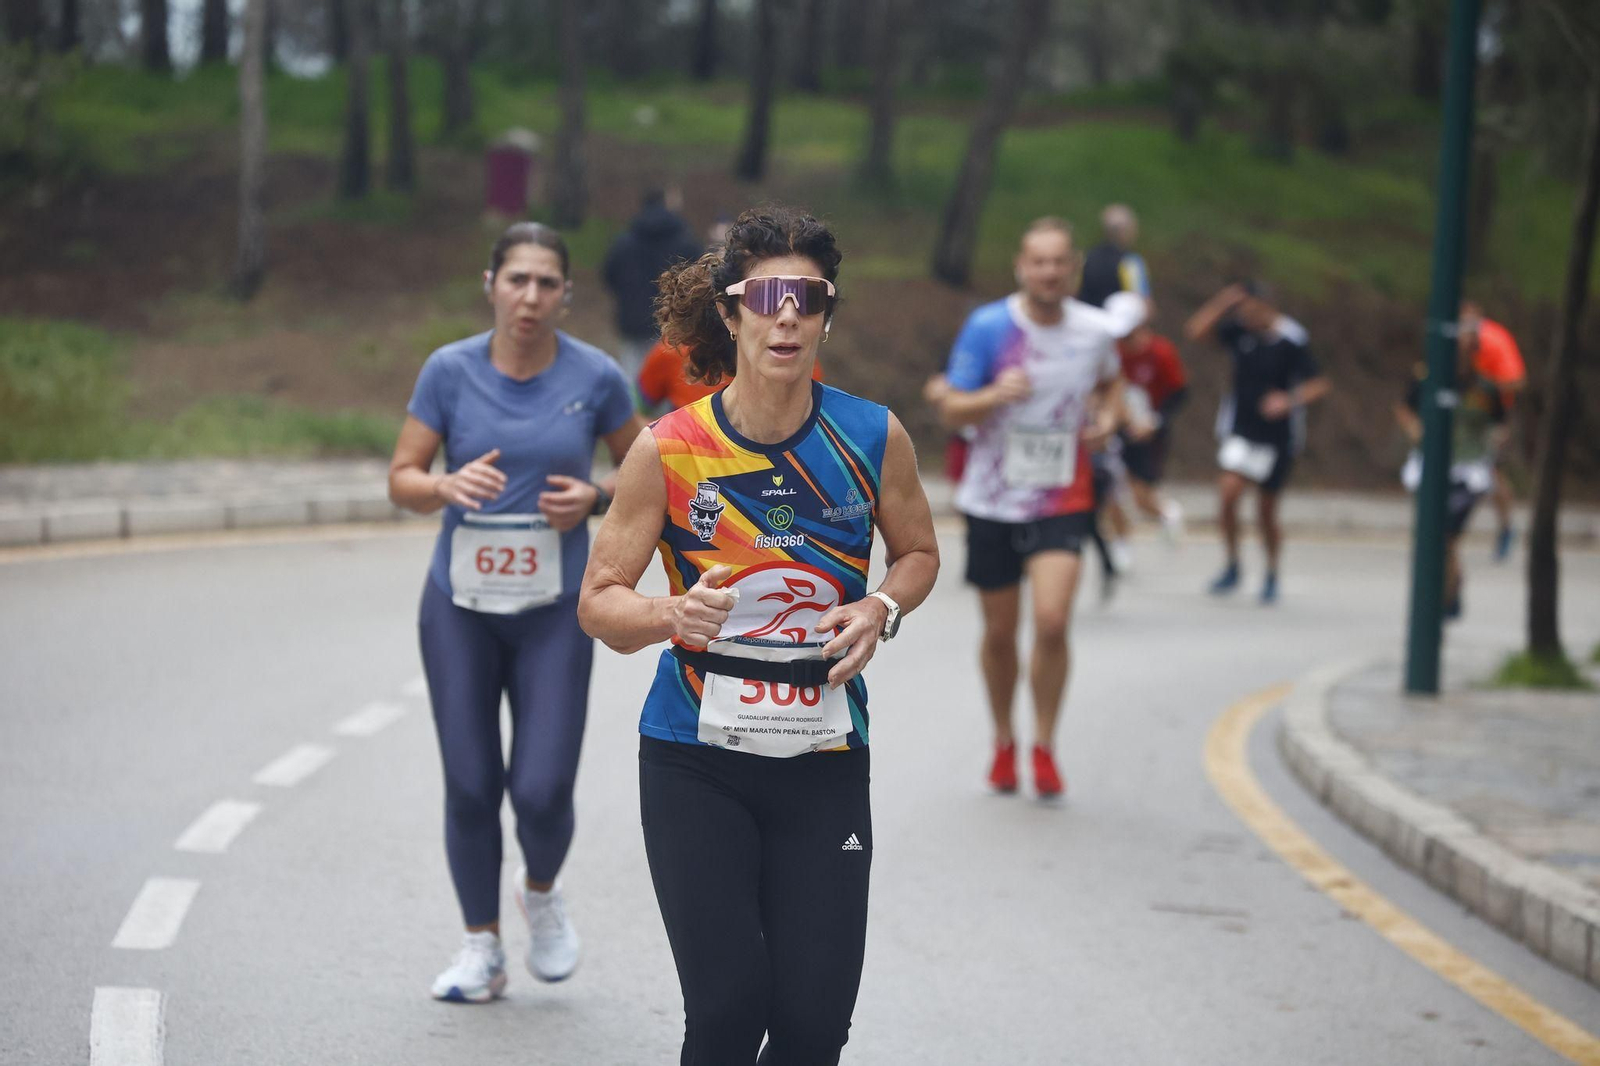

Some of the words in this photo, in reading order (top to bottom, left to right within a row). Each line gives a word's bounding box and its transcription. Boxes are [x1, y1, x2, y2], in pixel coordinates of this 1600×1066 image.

[761, 488, 797, 497] SPALL
[754, 534, 805, 549] fisio360
[475, 546, 538, 575] 623
[737, 713, 770, 721] GUADALUPE
[771, 715, 795, 723] ARÉVALO
[749, 726, 781, 734] MARATÓN
[811, 728, 836, 736] BASTÓN
[841, 843, 863, 851] adidas
